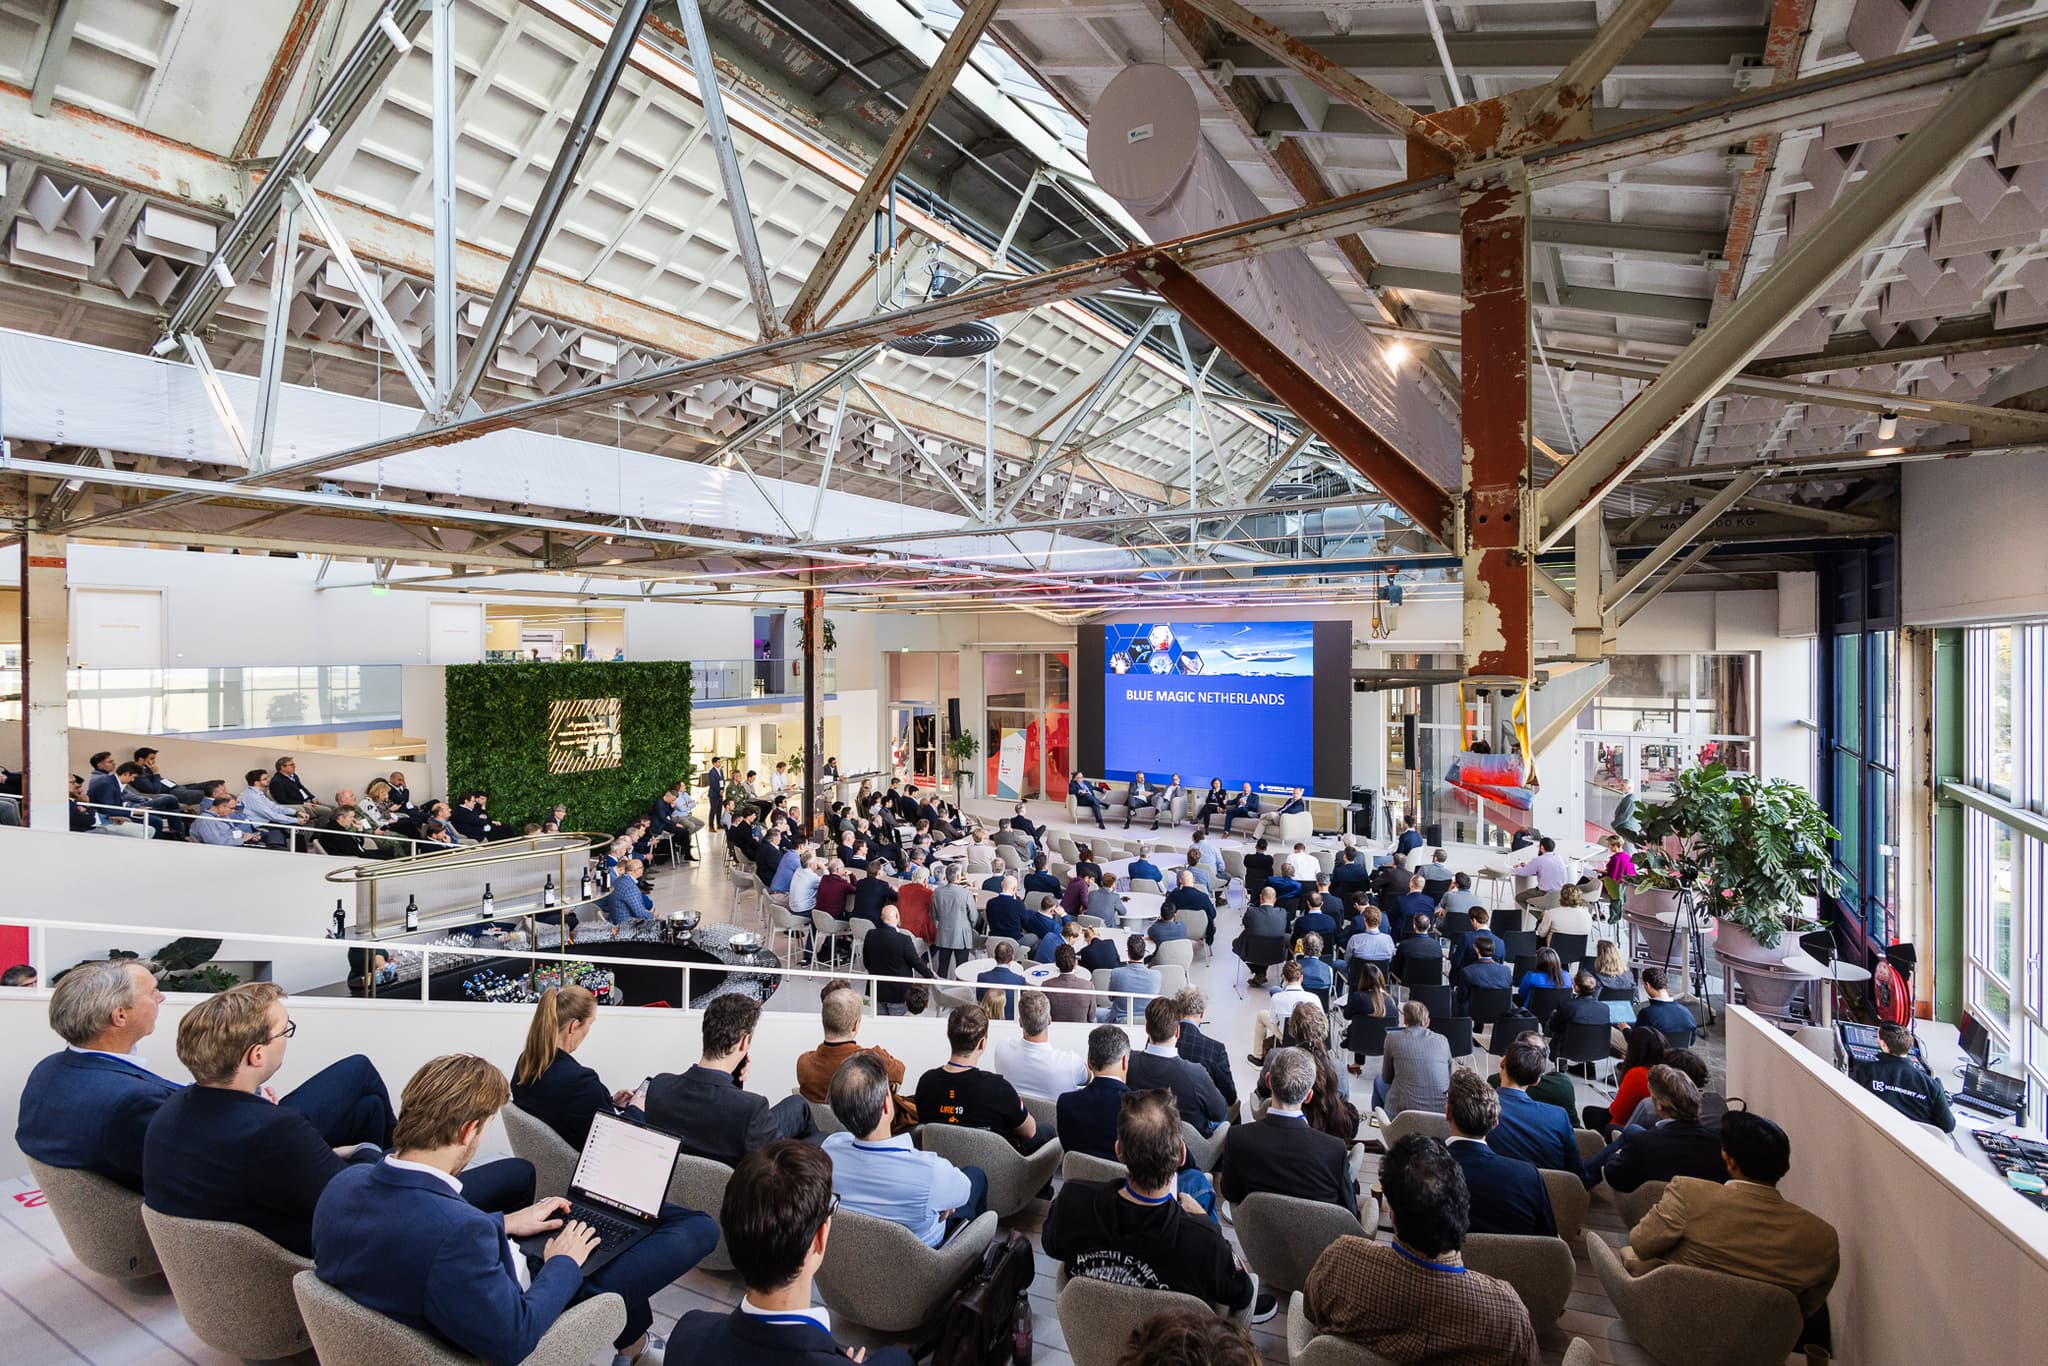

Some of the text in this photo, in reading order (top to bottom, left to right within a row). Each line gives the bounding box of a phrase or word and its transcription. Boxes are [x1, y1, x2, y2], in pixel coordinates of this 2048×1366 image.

[1737, 517, 1755, 527] KG
[1126, 690, 1285, 705] BLUE MAGIC NETHERLANDS
